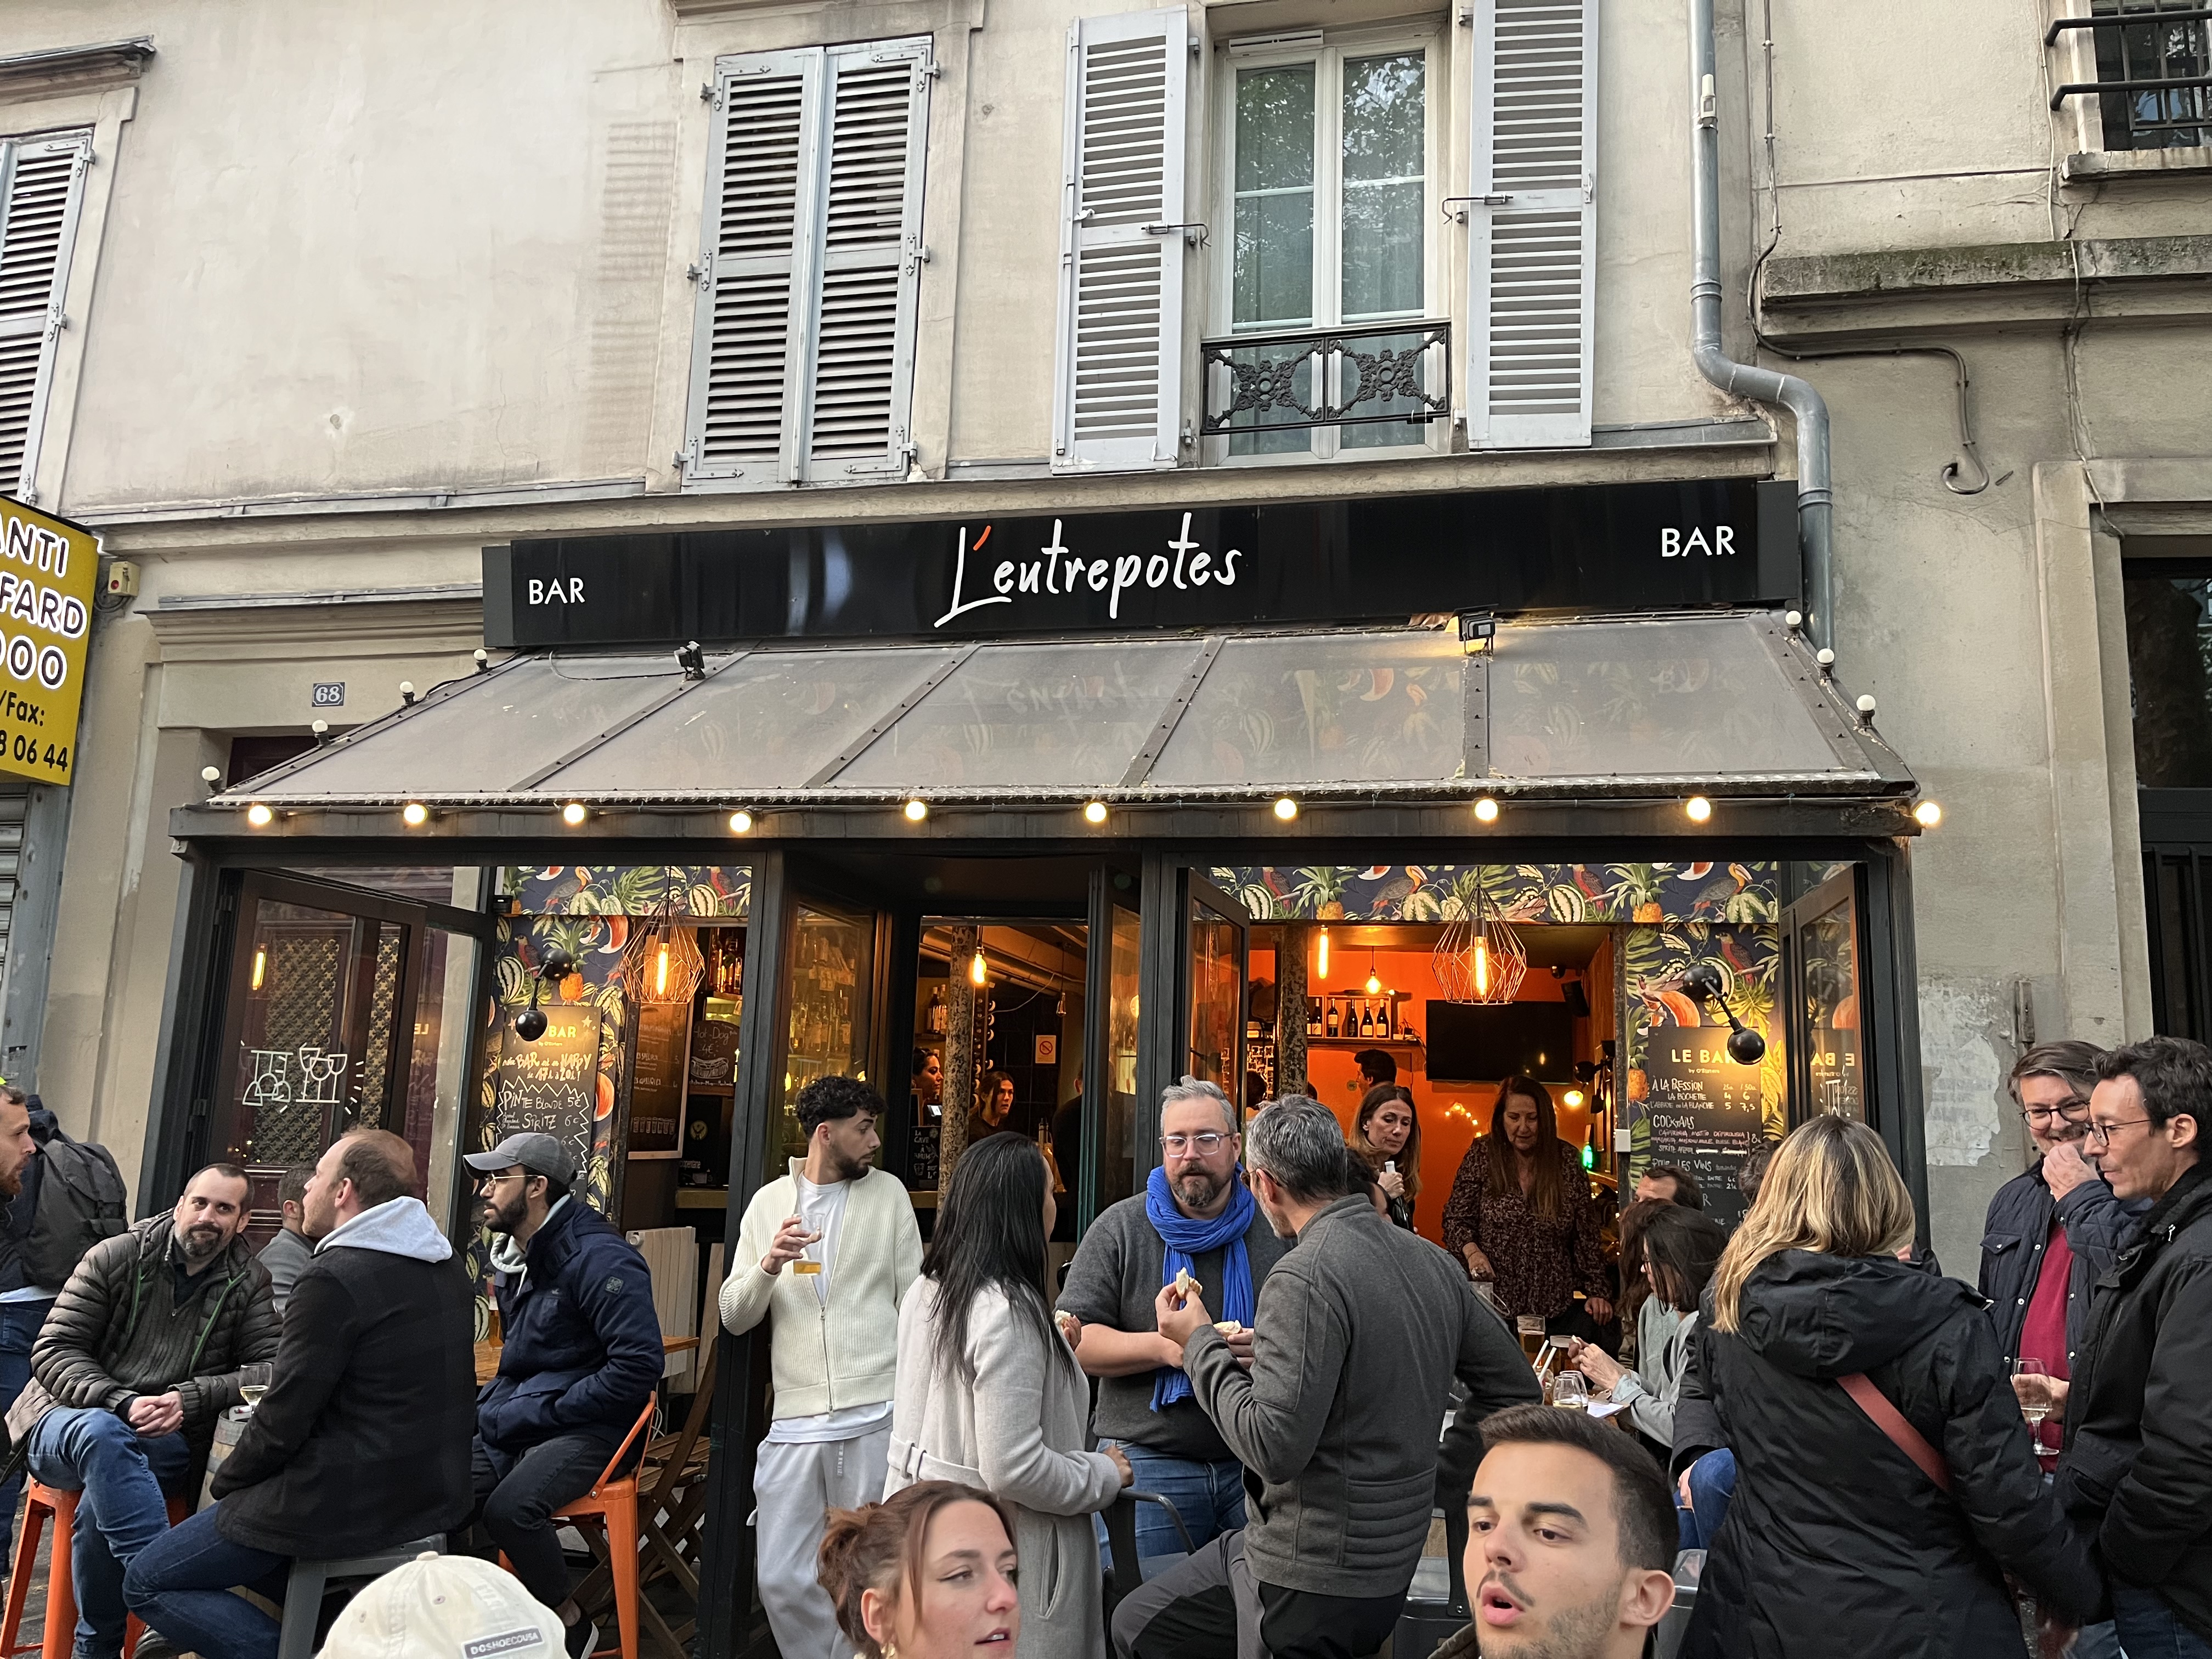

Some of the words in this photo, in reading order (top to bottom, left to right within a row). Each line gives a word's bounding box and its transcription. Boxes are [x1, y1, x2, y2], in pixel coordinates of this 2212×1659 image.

[0, 512, 69, 578] NTI
[1662, 526, 1735, 557] BAR
[934, 512, 1242, 628] L'entrepotes
[529, 578, 585, 605] BAR
[315, 686, 340, 702] 68
[14, 735, 37, 764] 06
[43, 743, 67, 772] 44
[549, 1025, 577, 1038] BAR
[693, 1026, 708, 1038] Hot
[712, 1026, 729, 1045] Dog
[702, 1044, 714, 1054] 4€
[1672, 1049, 1692, 1063] LE
[515, 1051, 540, 1070] BAR
[560, 1053, 592, 1071] HAPPY
[1661, 1079, 1669, 1091] LA
[1743, 1091, 1750, 1101] 6
[1689, 1102, 1714, 1110] BLANCHE
[1678, 1159, 1690, 1171] LES
[1694, 1159, 1712, 1171] VINS
